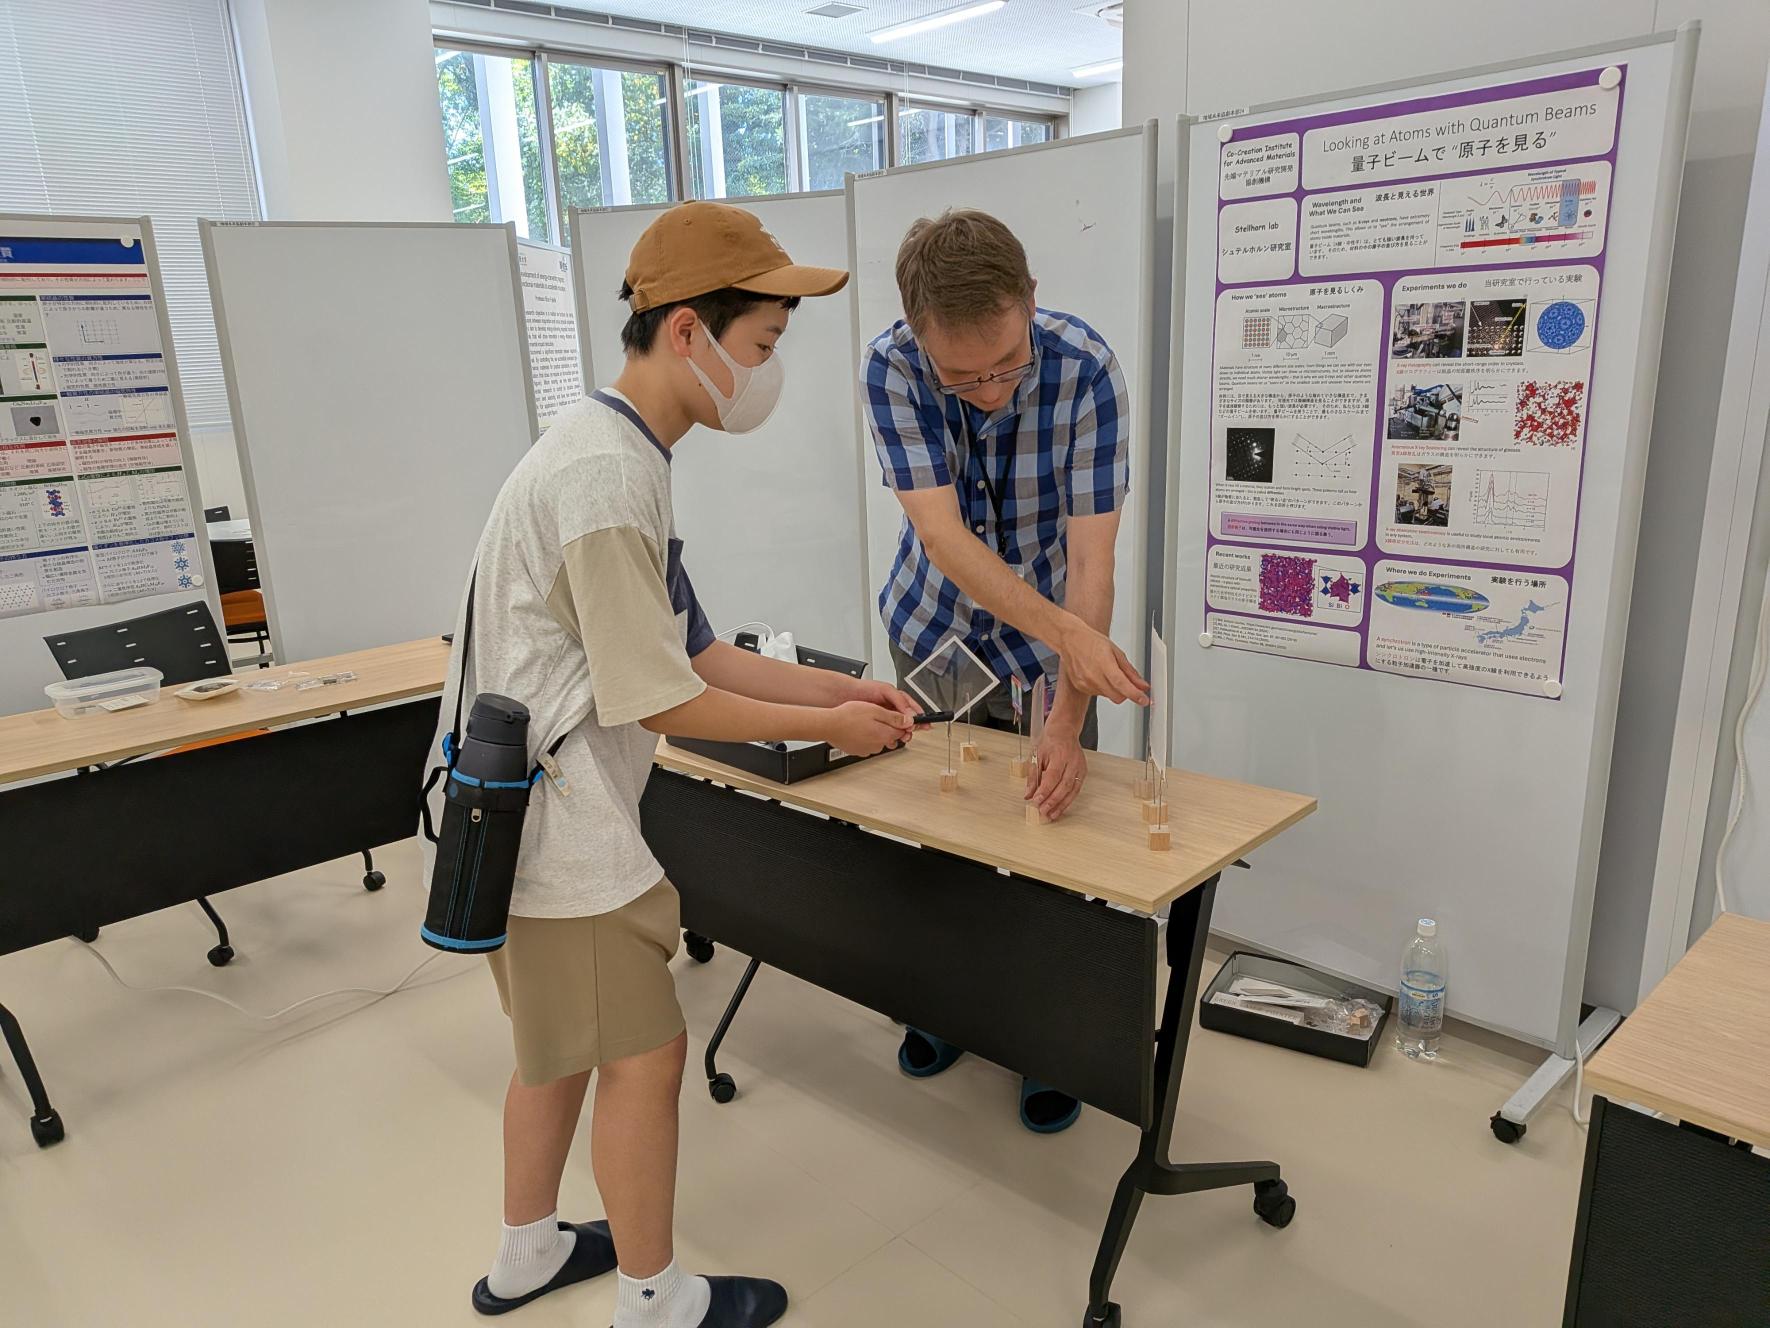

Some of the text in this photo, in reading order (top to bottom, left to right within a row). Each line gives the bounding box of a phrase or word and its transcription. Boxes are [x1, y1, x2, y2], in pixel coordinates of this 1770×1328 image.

[1323, 103, 1597, 153] Looking at Atoms with Quantum Beams
[1226, 142, 1293, 158] Co-Creation Institute
[1224, 150, 1296, 168] for Advanced Materials
[1311, 197, 1362, 209] Wavelength and
[1308, 205, 1364, 217] What We Can See
[1235, 221, 1279, 234] Stellhorn lab
[1222, 241, 1292, 257] シュテルホルン研究室
[1402, 284, 1445, 292] Experiments
[1457, 281, 1468, 289] do
[1484, 273, 1583, 288] 当研究室で行っている実験
[1268, 291, 1287, 299] atoms
[1215, 550, 1233, 558] Recent
[1386, 566, 1407, 575] Where
[1428, 571, 1472, 581] Experiments
[1490, 576, 1547, 588] 実験を行う場所
[1440, 645, 1460, 653] particle
[1461, 647, 1492, 656] accelerator
[1519, 655, 1547, 664] electrons
